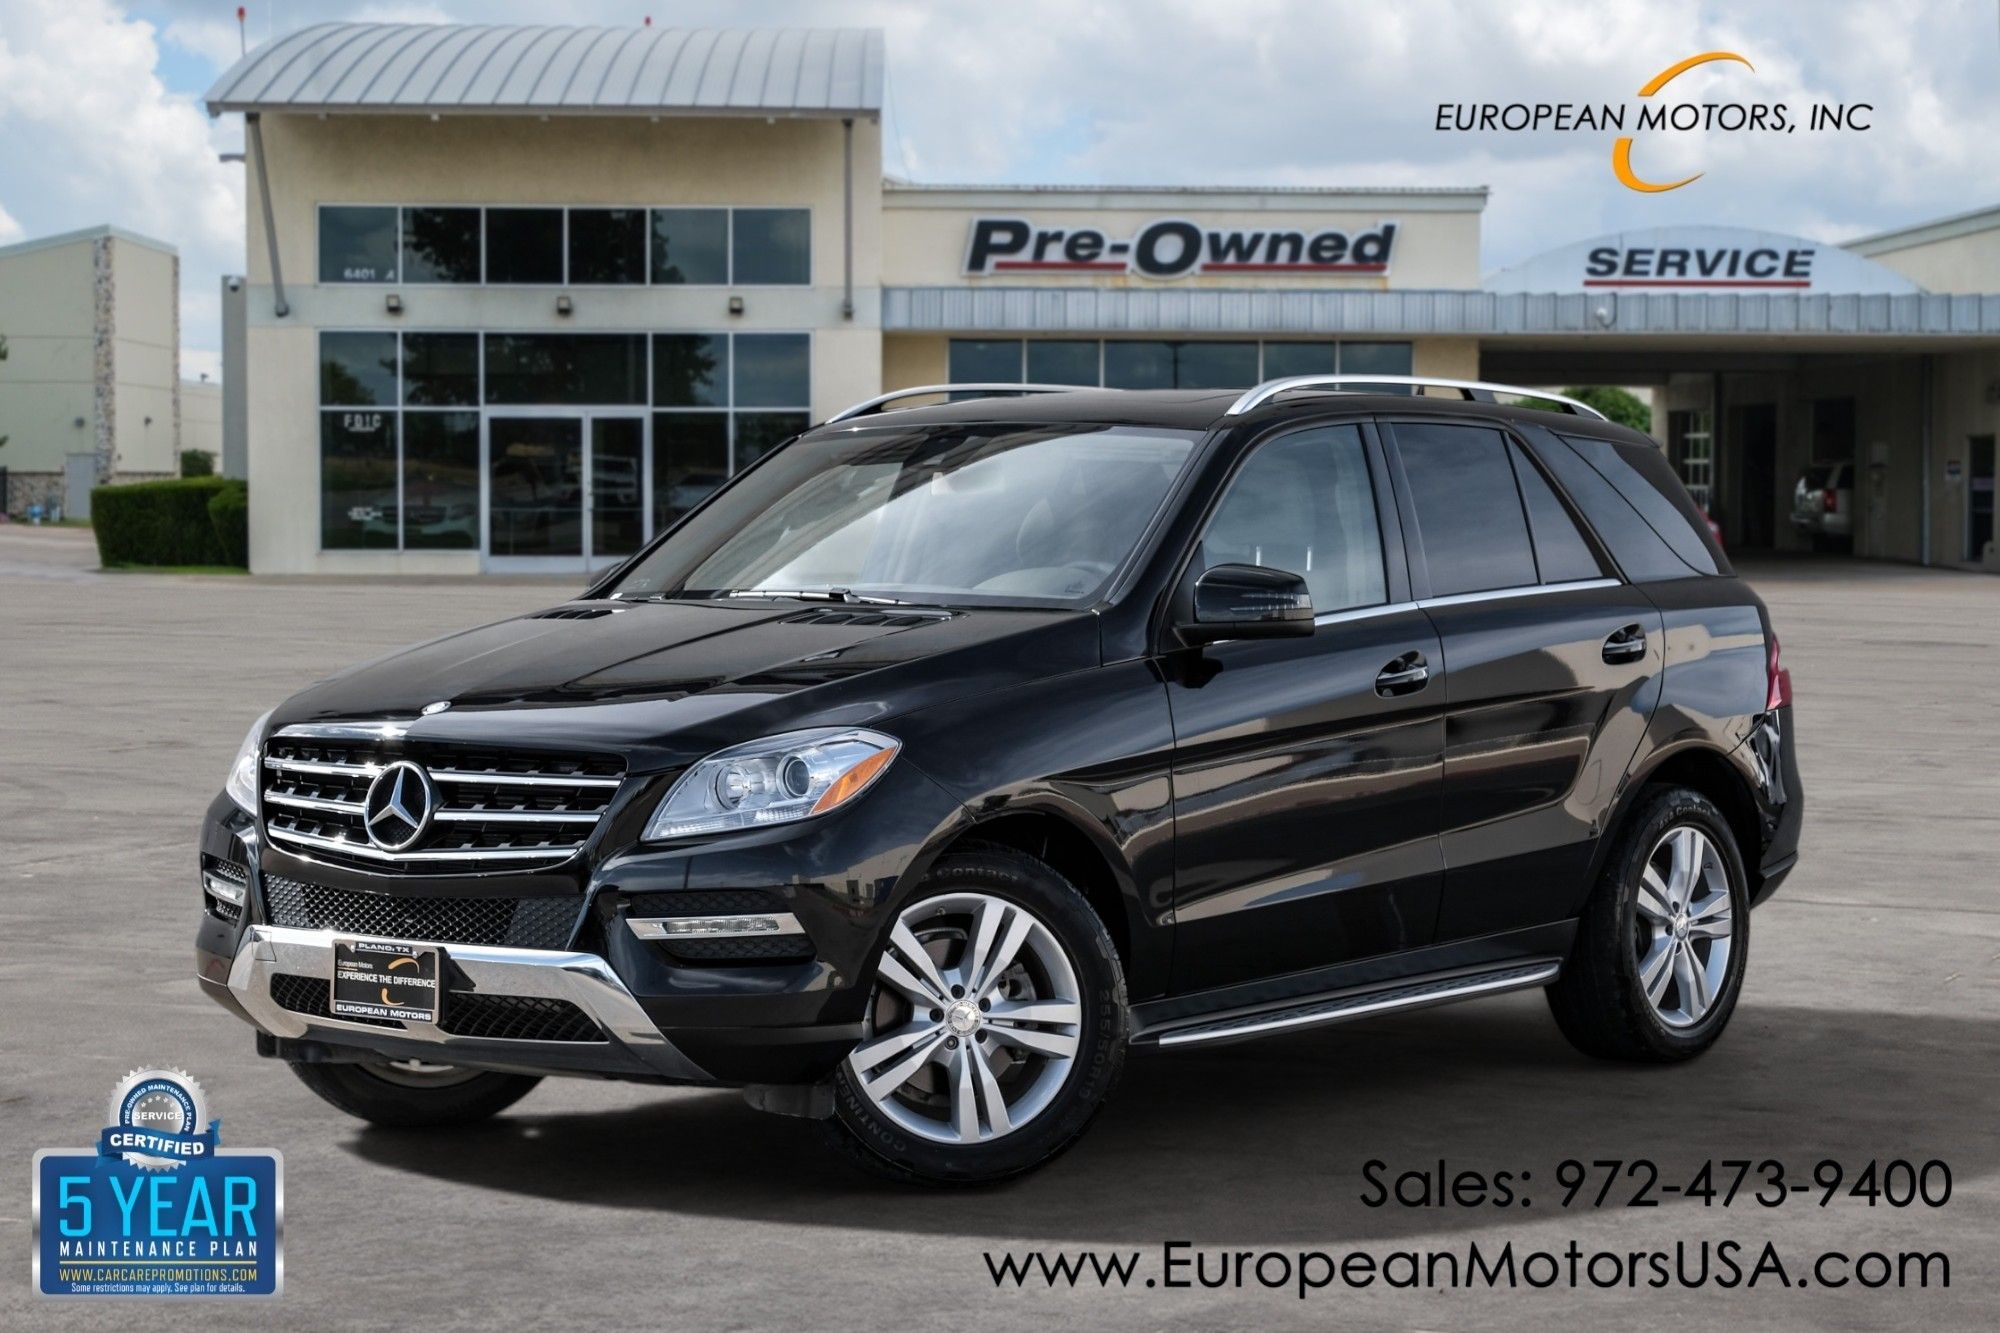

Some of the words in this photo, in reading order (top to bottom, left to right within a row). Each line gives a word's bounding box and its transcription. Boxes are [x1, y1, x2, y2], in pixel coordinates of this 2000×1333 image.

[966, 219, 1396, 276] Pre-Owned
[1585, 247, 1816, 278] SERVICE
[337, 970, 378, 983] EXPERIENCE
[379, 974, 393, 984] THE
[393, 976, 435, 988] DIFFERENCE
[336, 1003, 388, 1016] EUROPEAN
[390, 1009, 431, 1021] MOTORS
